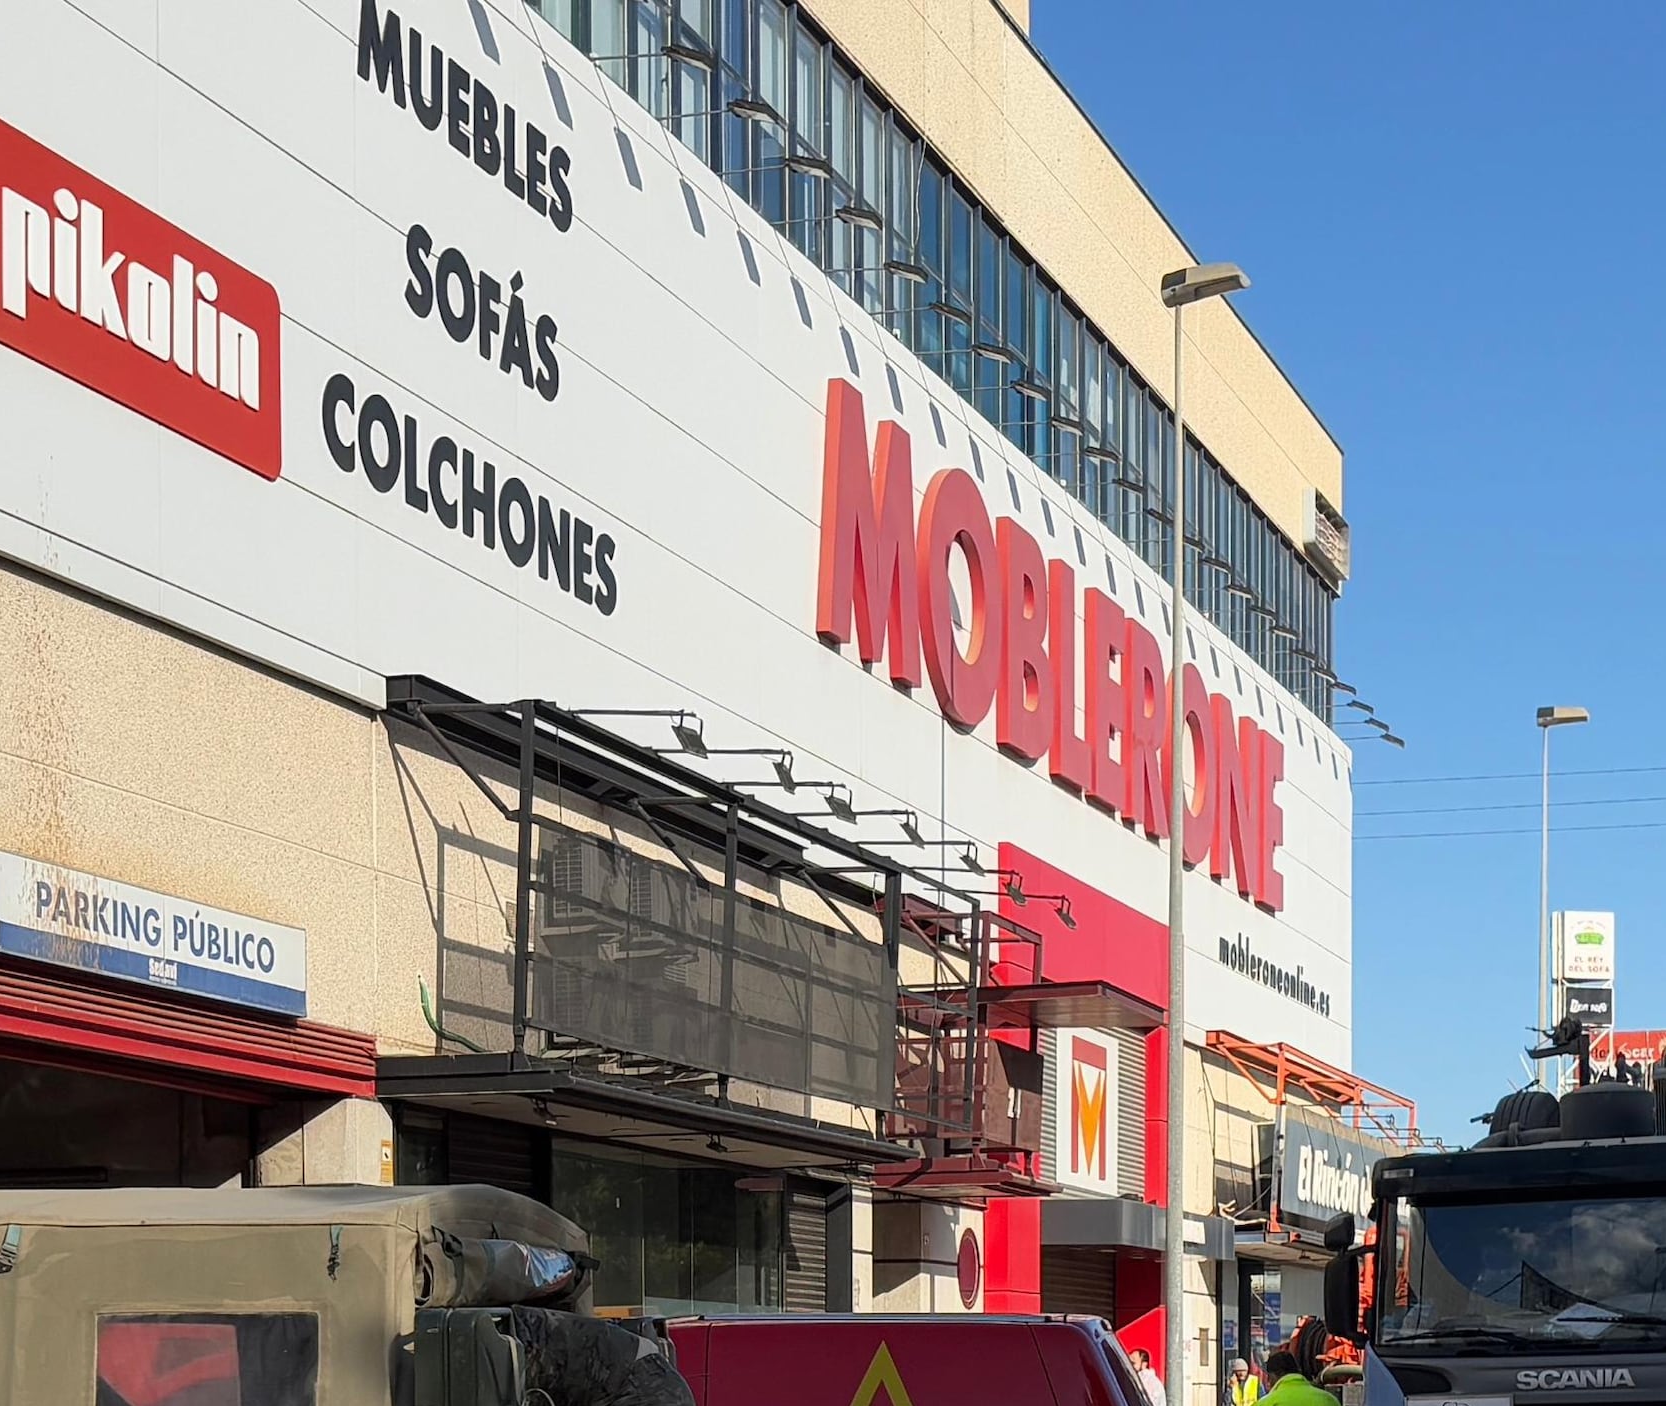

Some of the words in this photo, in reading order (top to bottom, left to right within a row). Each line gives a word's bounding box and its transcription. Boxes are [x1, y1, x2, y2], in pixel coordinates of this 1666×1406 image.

[358, 0, 573, 233] MUEBLES
[2, 186, 260, 412] pikolin
[405, 224, 559, 401] SOFÁS
[322, 373, 618, 616] COLCHONES
[816, 377, 1284, 914] MOBLERONE
[36, 881, 162, 947] PARKING
[173, 909, 275, 974] PÚBLICO
[1219, 932, 1331, 1018] mobleroneonline.es
[1297, 1144, 1313, 1202] El
[1312, 1148, 1360, 1216] Rincón
[1516, 1368, 1636, 1390] SCANIA
